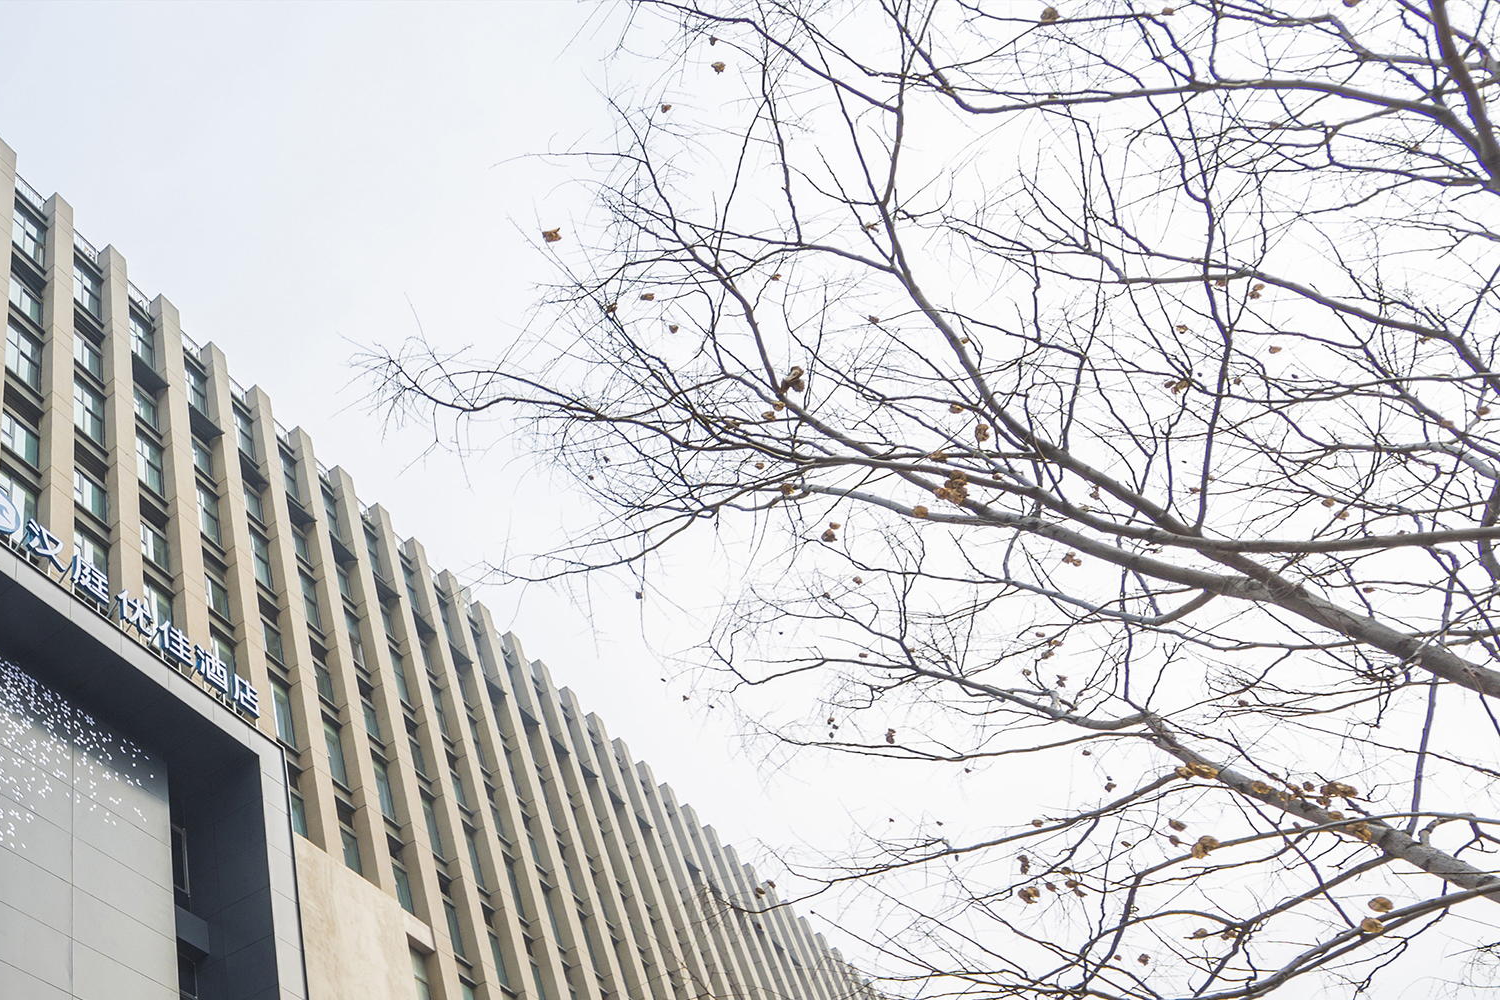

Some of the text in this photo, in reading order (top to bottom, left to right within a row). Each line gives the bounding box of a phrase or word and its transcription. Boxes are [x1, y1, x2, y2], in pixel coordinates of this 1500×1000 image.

[26, 518, 260, 719] 汉庭优佳酒店
